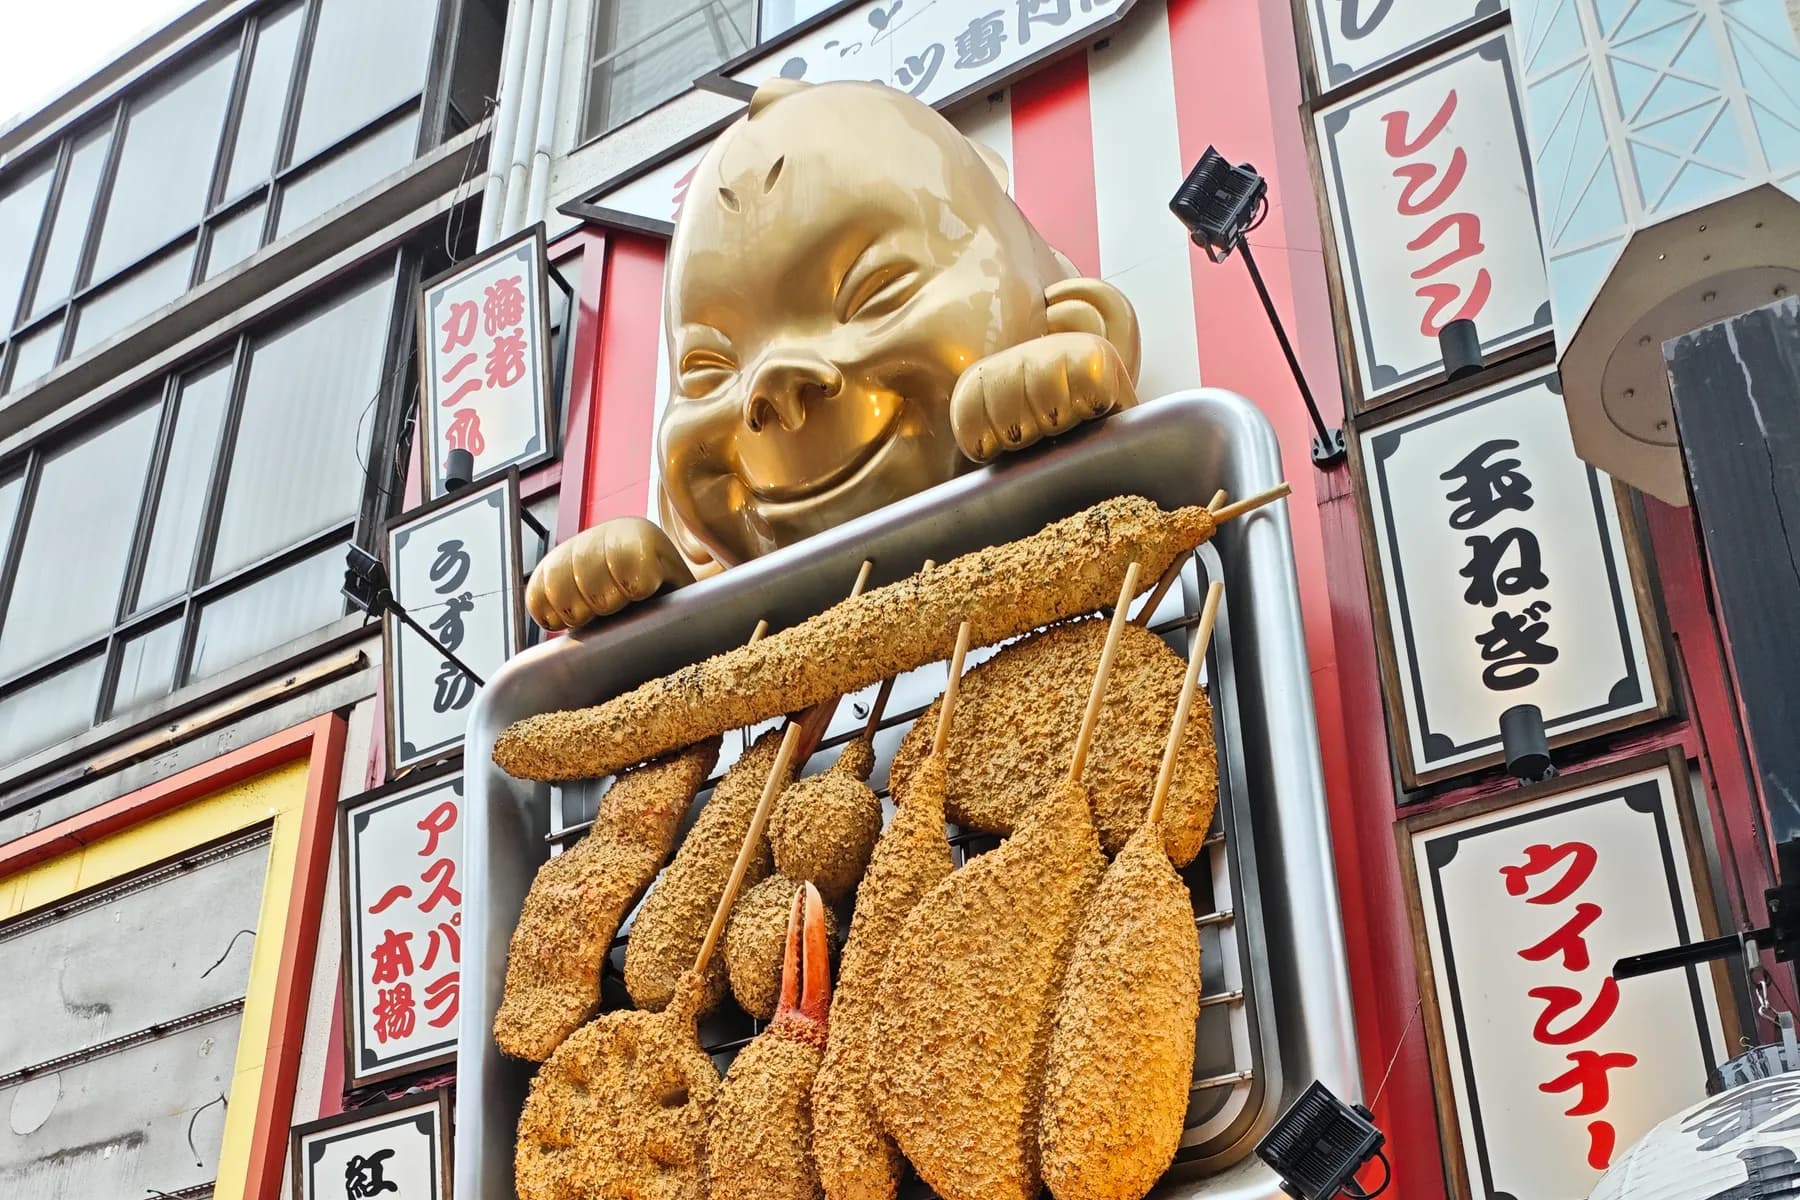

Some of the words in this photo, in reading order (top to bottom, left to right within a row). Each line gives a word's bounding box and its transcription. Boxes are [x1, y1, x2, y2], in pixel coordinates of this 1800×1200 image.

[873, 0, 1116, 97] ツ専門
[1380, 88, 1492, 338] レンコン
[484, 275, 528, 388] 海老
[430, 539, 476, 714] うずら
[1439, 439, 1559, 691] 玉ねぎ
[369, 884, 416, 1044] 一本揚
[417, 801, 462, 1029] アスパラ
[1499, 841, 1638, 1170] ウインナー
